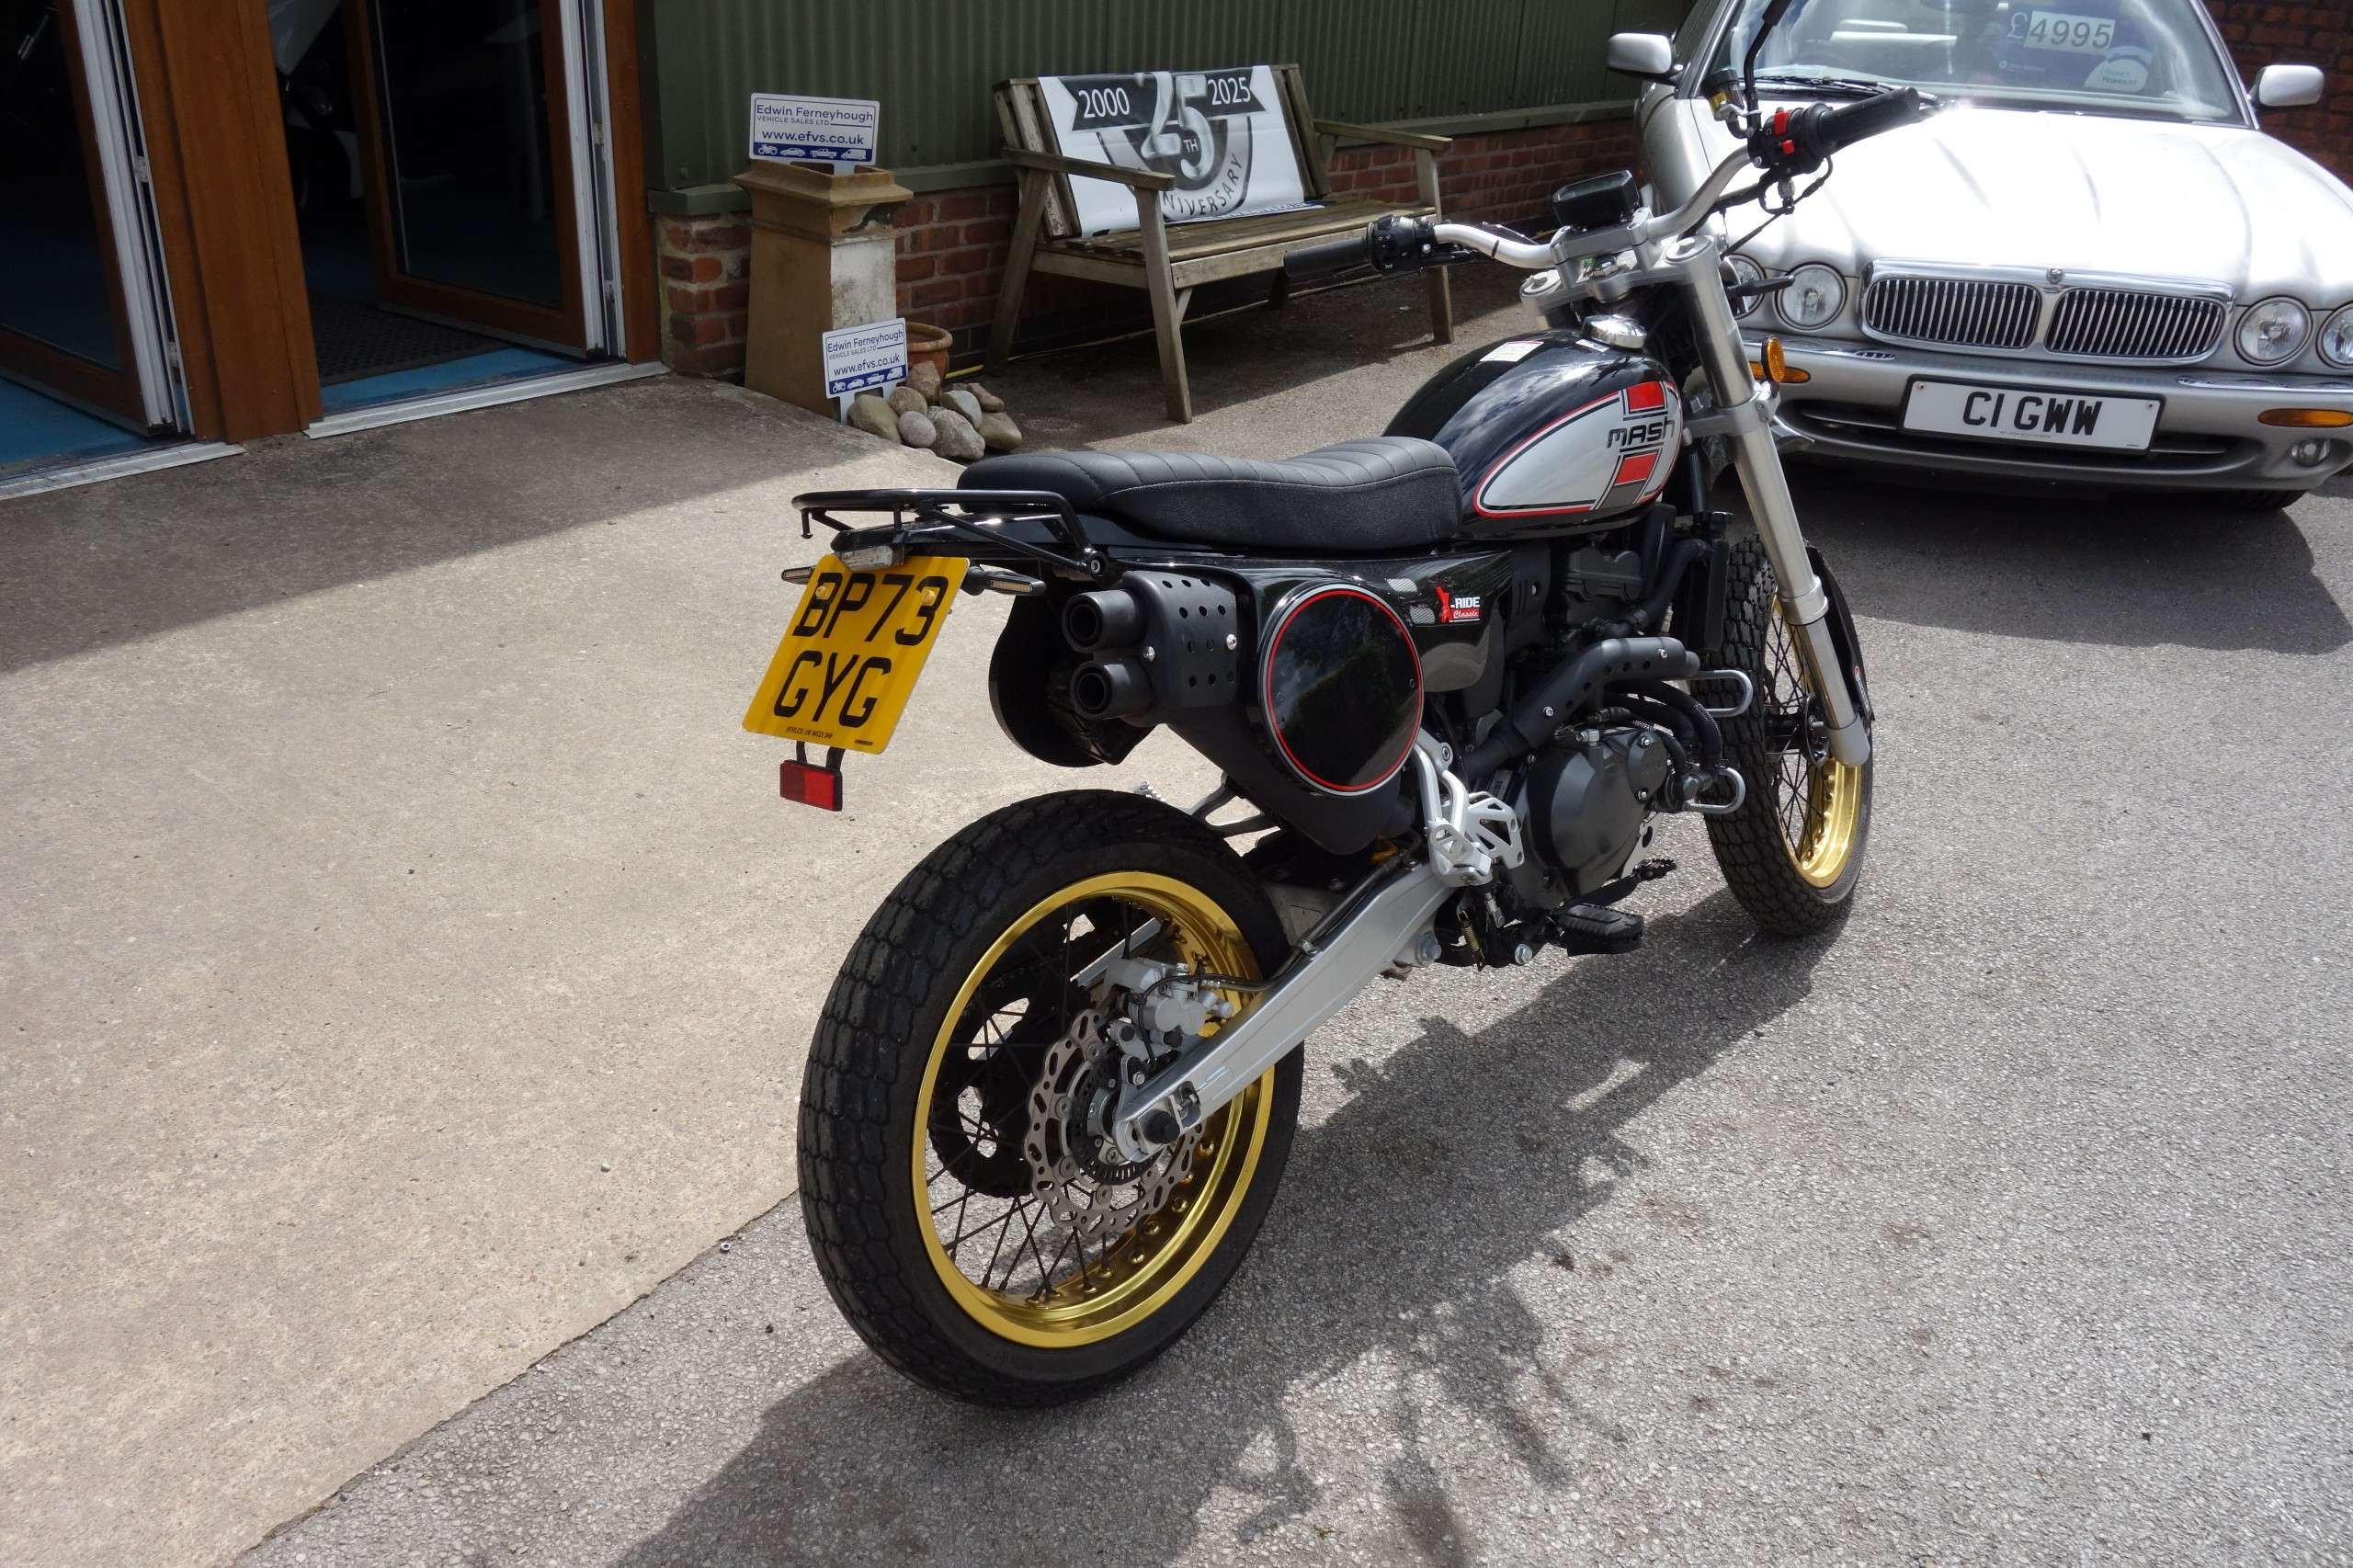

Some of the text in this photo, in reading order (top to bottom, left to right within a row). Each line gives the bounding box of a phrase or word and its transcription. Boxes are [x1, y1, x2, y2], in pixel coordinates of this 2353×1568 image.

[2007, 12, 2112, 48] £4995
[1078, 86, 1131, 119] 2000
[1207, 76, 1252, 106] 2025
[756, 104, 873, 122] Edwin Ferneyhough
[790, 117, 814, 125] SALES
[761, 131, 865, 145] www.efvs.co.uk
[1183, 138, 1199, 153] TH
[1162, 153, 1244, 216] NIVERSARY
[827, 329, 904, 353] Edwin Ferneyhough
[829, 350, 850, 360] VEHICLE
[833, 352, 901, 376] www.efvs.co.uk
[1962, 391, 2103, 437] C1 GWW
[792, 572, 949, 646] BP73
[1452, 608, 1480, 619] Classic
[774, 650, 892, 728] GYG
